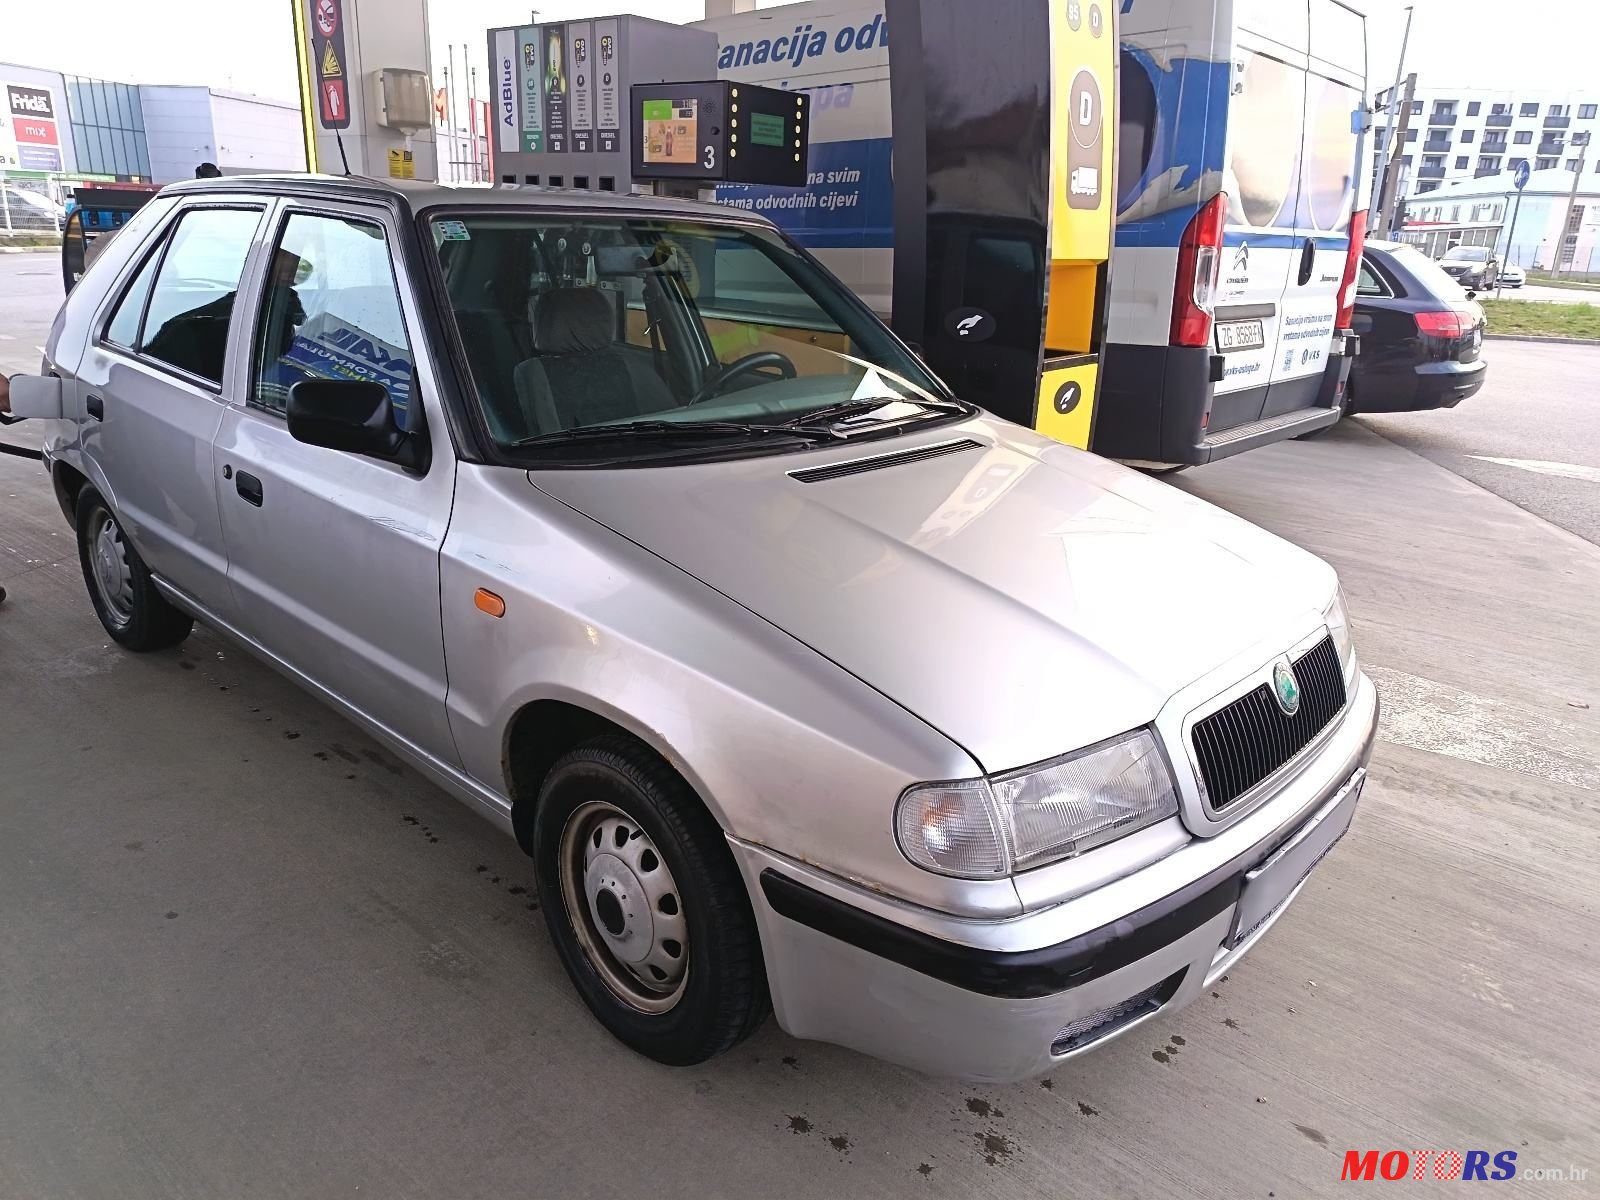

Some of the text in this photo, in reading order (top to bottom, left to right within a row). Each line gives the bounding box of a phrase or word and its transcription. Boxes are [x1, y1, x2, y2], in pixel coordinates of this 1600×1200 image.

[1068, 4, 1079, 21] 95
[1092, 11, 1099, 28] D
[717, 24, 827, 70] anacija
[1079, 90, 1093, 126] D
[703, 145, 715, 169] 3
[807, 167, 860, 185] na svim
[755, 193, 817, 210] odvodnih
[819, 190, 858, 211] cijevi
[1222, 327, 1233, 346] ZG
